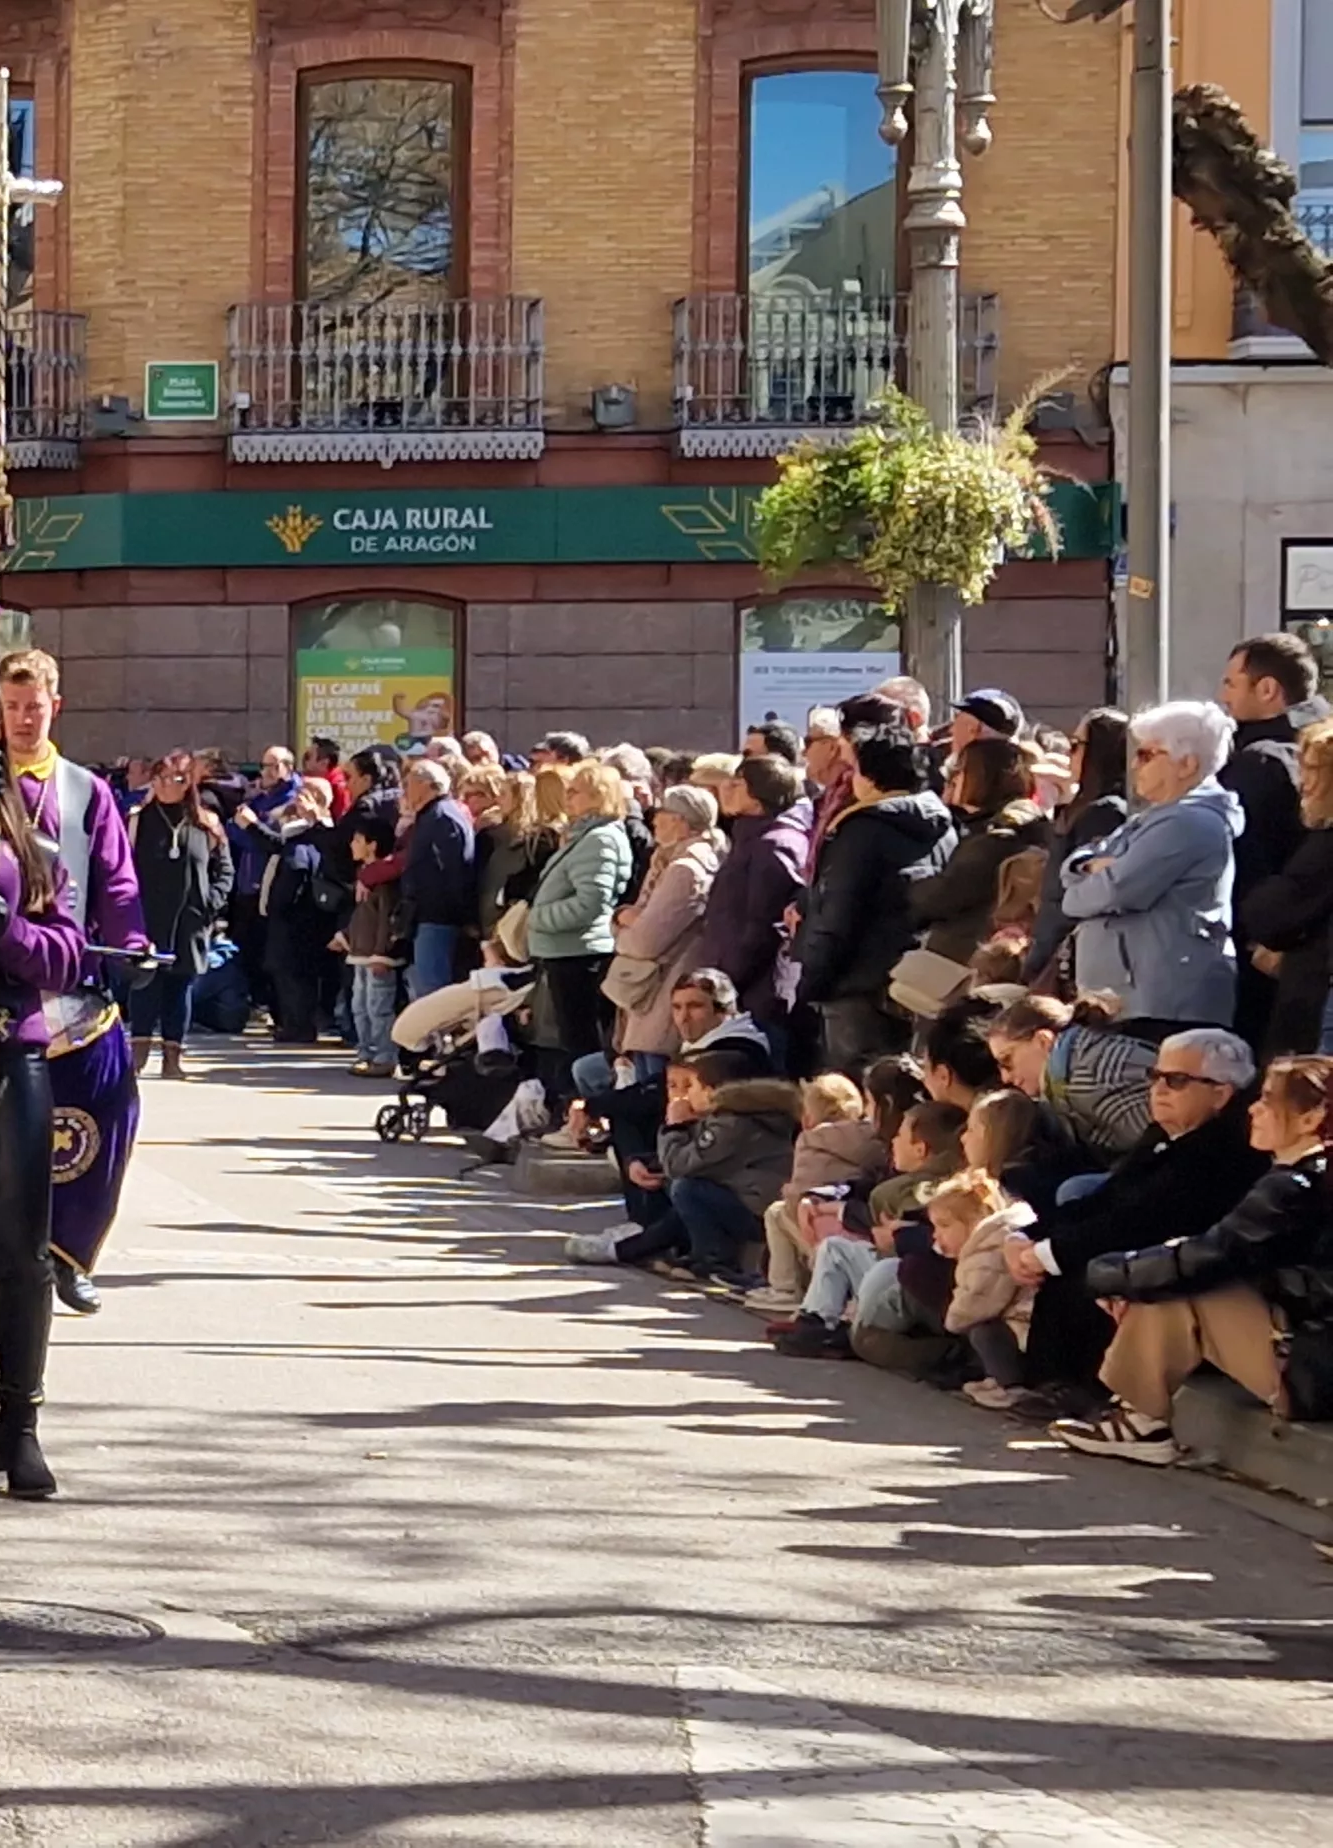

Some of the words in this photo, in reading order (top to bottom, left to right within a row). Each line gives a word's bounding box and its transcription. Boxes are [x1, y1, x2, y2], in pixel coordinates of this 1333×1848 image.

[333, 508, 399, 530] CAJA
[405, 506, 493, 529] RURAL
[351, 536, 379, 552] DE
[383, 533, 476, 552] ARAGÓN
[307, 684, 325, 695] TU
